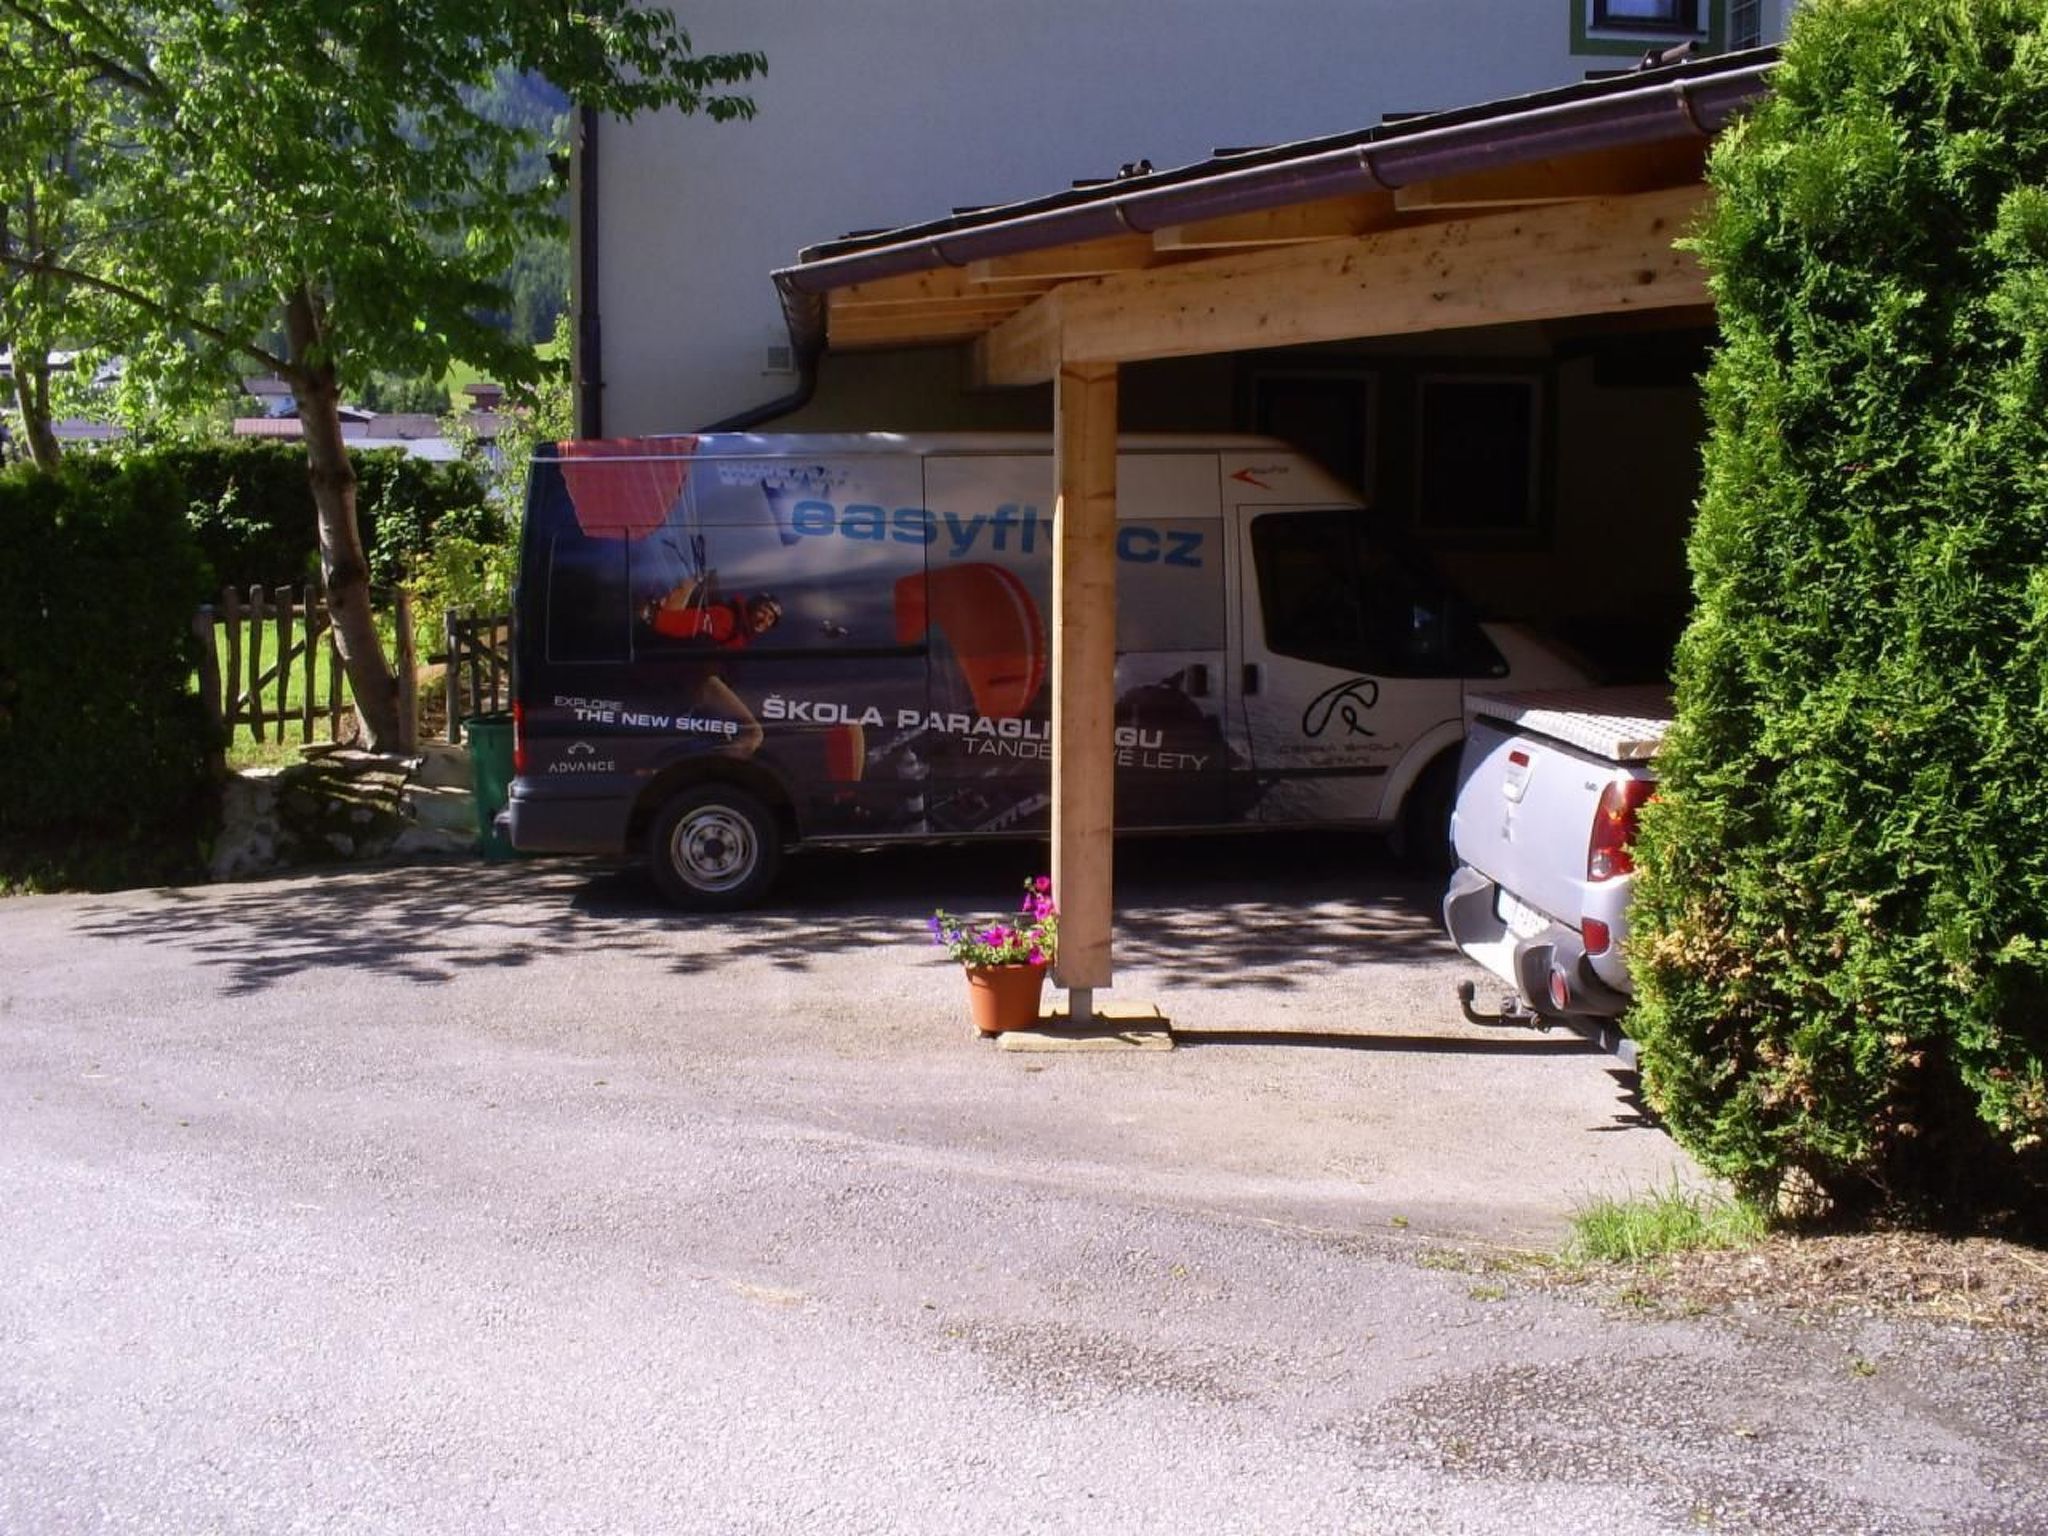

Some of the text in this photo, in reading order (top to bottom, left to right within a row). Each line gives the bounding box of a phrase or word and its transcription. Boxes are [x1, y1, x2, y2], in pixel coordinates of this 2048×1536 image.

[792, 500, 1204, 568] easyflcz
[554, 696, 623, 711] EXPLORE
[575, 708, 738, 734] THE NEW SKIES
[762, 694, 1163, 749] ŠKOLA PARAGLIGU
[549, 761, 616, 773] ADVANCE
[1143, 752, 1208, 771] LETY
